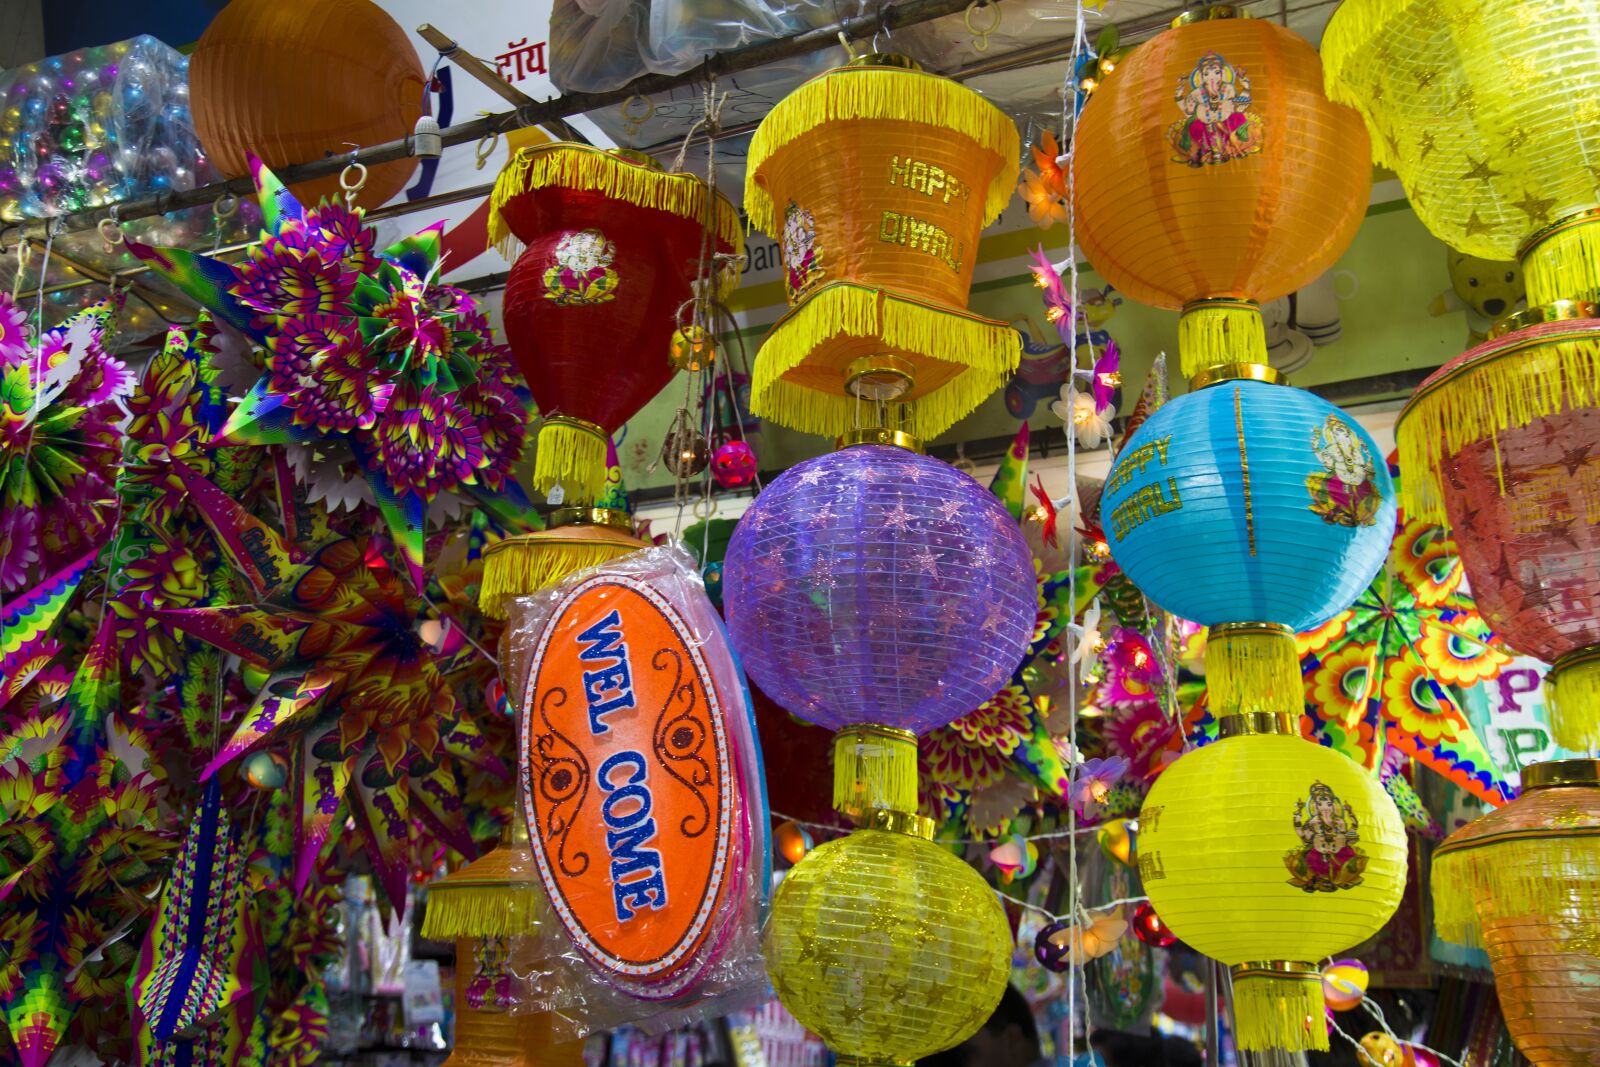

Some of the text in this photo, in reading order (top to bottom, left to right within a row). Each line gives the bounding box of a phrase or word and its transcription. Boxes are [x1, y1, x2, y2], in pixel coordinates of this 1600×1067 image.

[888, 153, 971, 215] HAPPY
[880, 210, 963, 273] DIWALI
[1106, 433, 1173, 500] HAPPY
[1111, 476, 1183, 543] DIWALI
[575, 609, 669, 923] WEL COME
